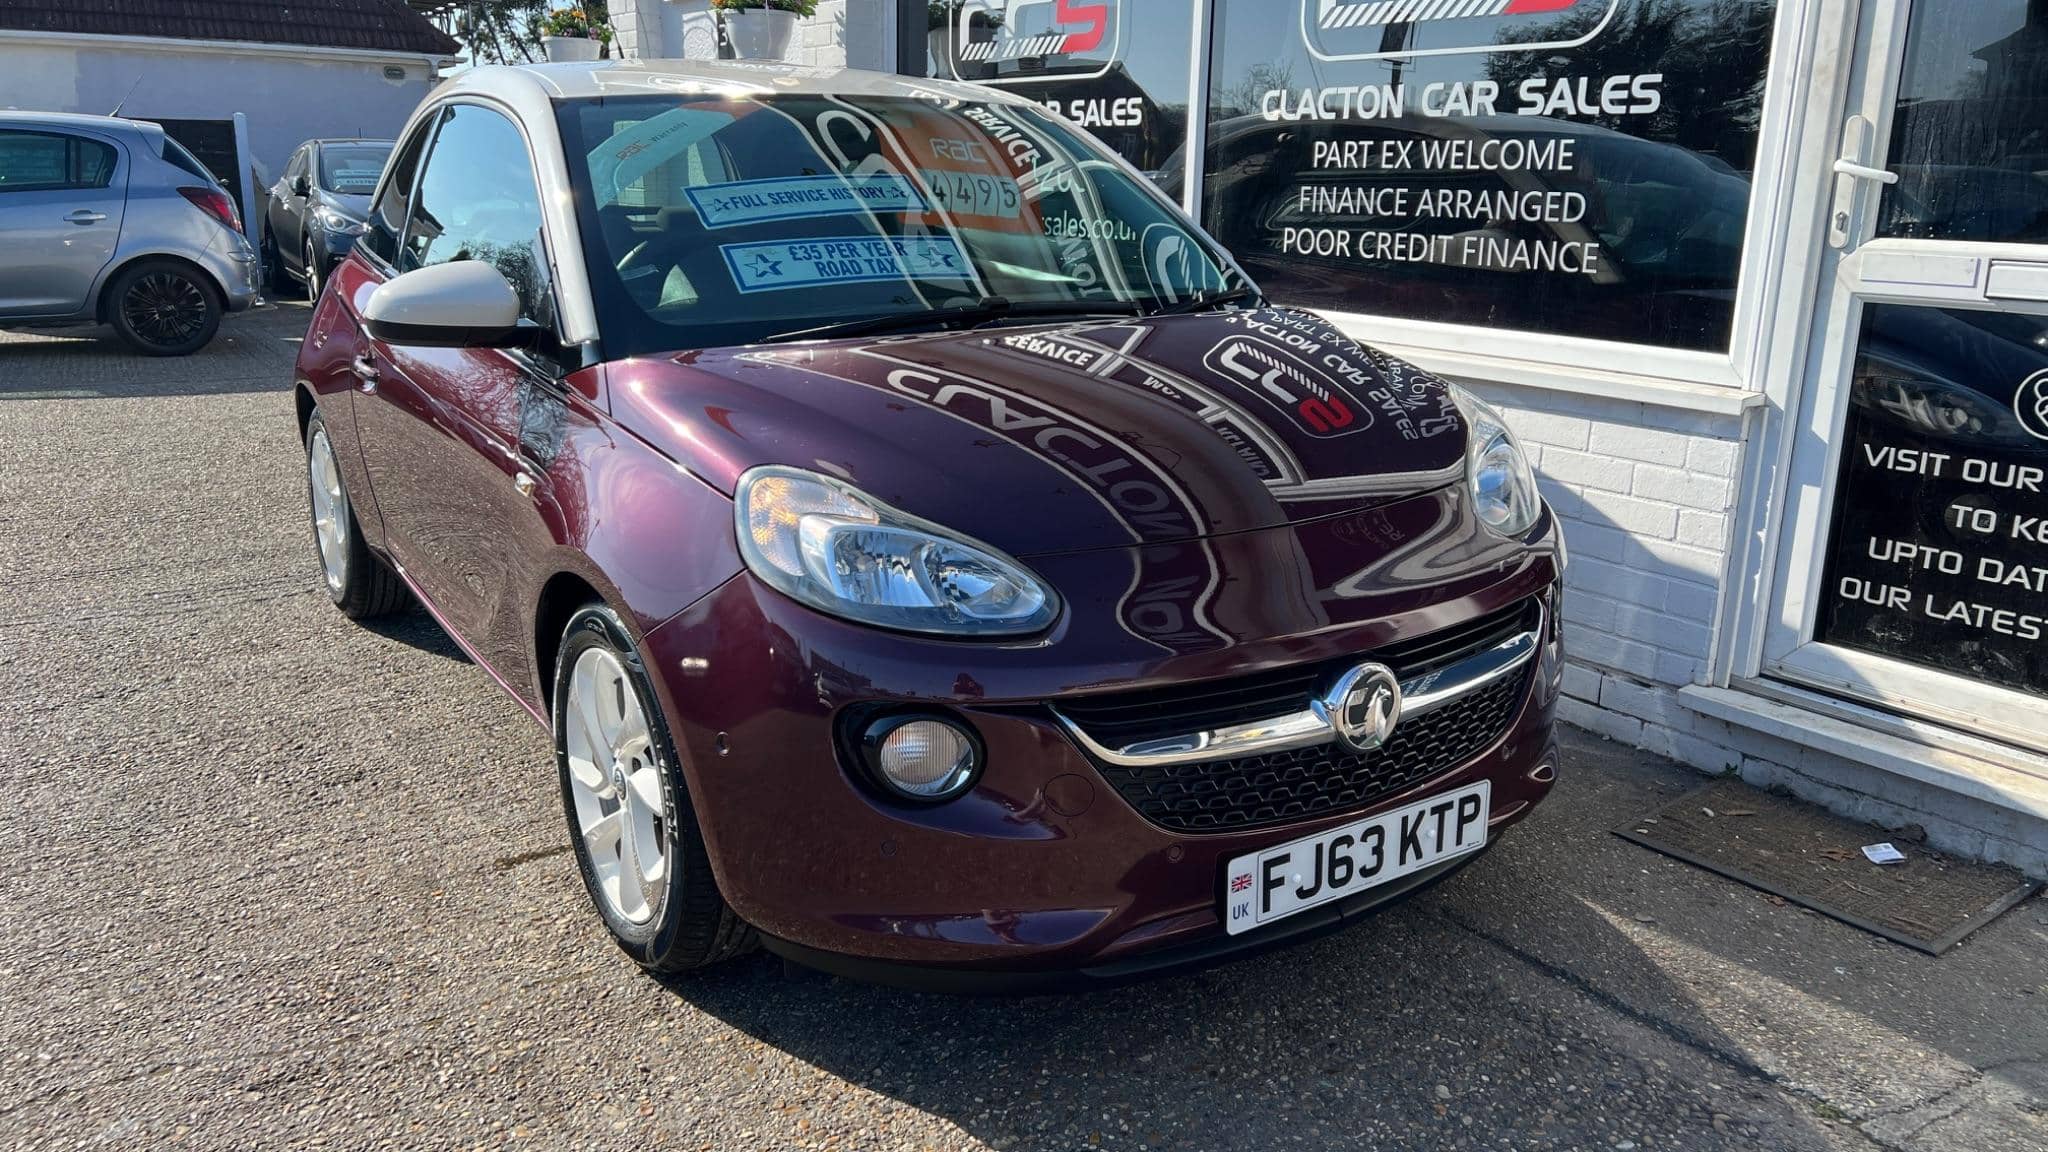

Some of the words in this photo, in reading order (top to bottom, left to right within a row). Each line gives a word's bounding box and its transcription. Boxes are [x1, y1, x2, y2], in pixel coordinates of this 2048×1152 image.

[1071, 97, 1143, 128] SALES
[1262, 83, 1405, 121] CLACTON
[1420, 80, 1499, 118] CAR
[1518, 73, 1663, 116] SALES
[1312, 139, 1374, 169] PART
[1380, 139, 1415, 170] EX
[1421, 139, 1576, 171] WELCOME
[729, 194, 769, 210] FULL
[770, 189, 827, 205] SERVICE
[1299, 185, 1409, 217] FINANCE
[1415, 188, 1587, 223] ARRANGED
[789, 244, 823, 262] £35
[826, 242, 858, 259] PER
[860, 241, 909, 258] YEAR
[815, 258, 864, 278] ROAD
[864, 257, 901, 275] TAX
[1282, 228, 1351, 258] POOR
[1359, 231, 1454, 265] CREDIT
[1462, 236, 1600, 275] FINANCE
[1863, 443, 1951, 477] VISIT
[1961, 458, 2044, 493] OUR
[1951, 504, 1997, 534] TO
[1868, 536, 1963, 575] UPTO
[1839, 576, 1912, 612] OUR
[1924, 594, 2048, 640] LATES
[1262, 824, 1386, 914] FJ63
[1399, 793, 1481, 867] KTP
[1232, 902, 1250, 921] UK
